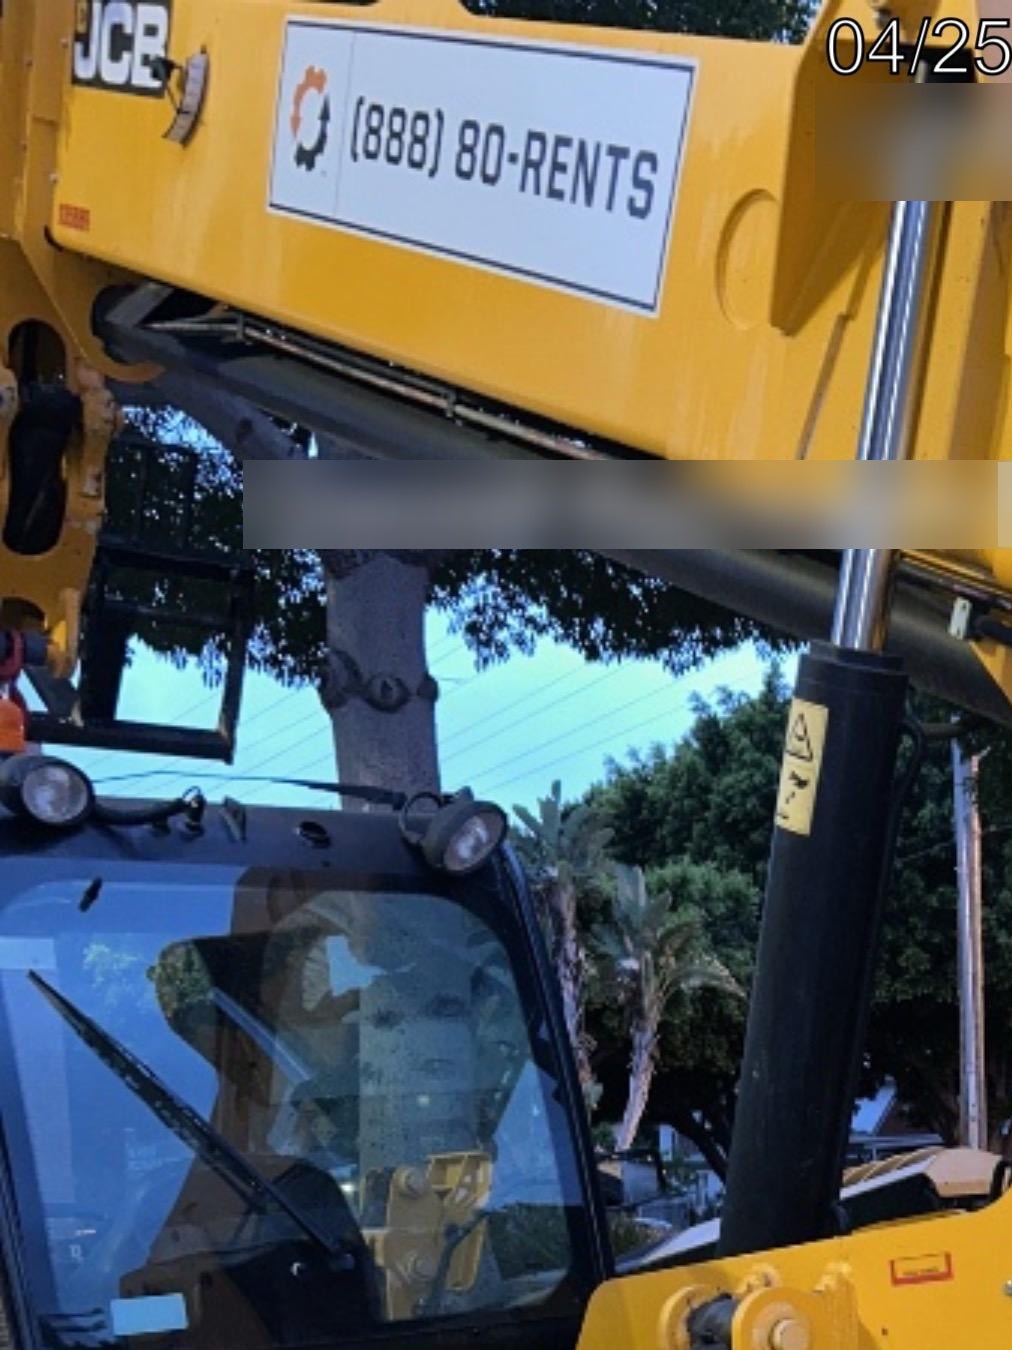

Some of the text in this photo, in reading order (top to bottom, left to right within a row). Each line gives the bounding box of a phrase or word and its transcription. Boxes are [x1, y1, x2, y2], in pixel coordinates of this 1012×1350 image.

[73, 0, 168, 88] JCB
[351, 96, 658, 219] (888) 80-RENTS
